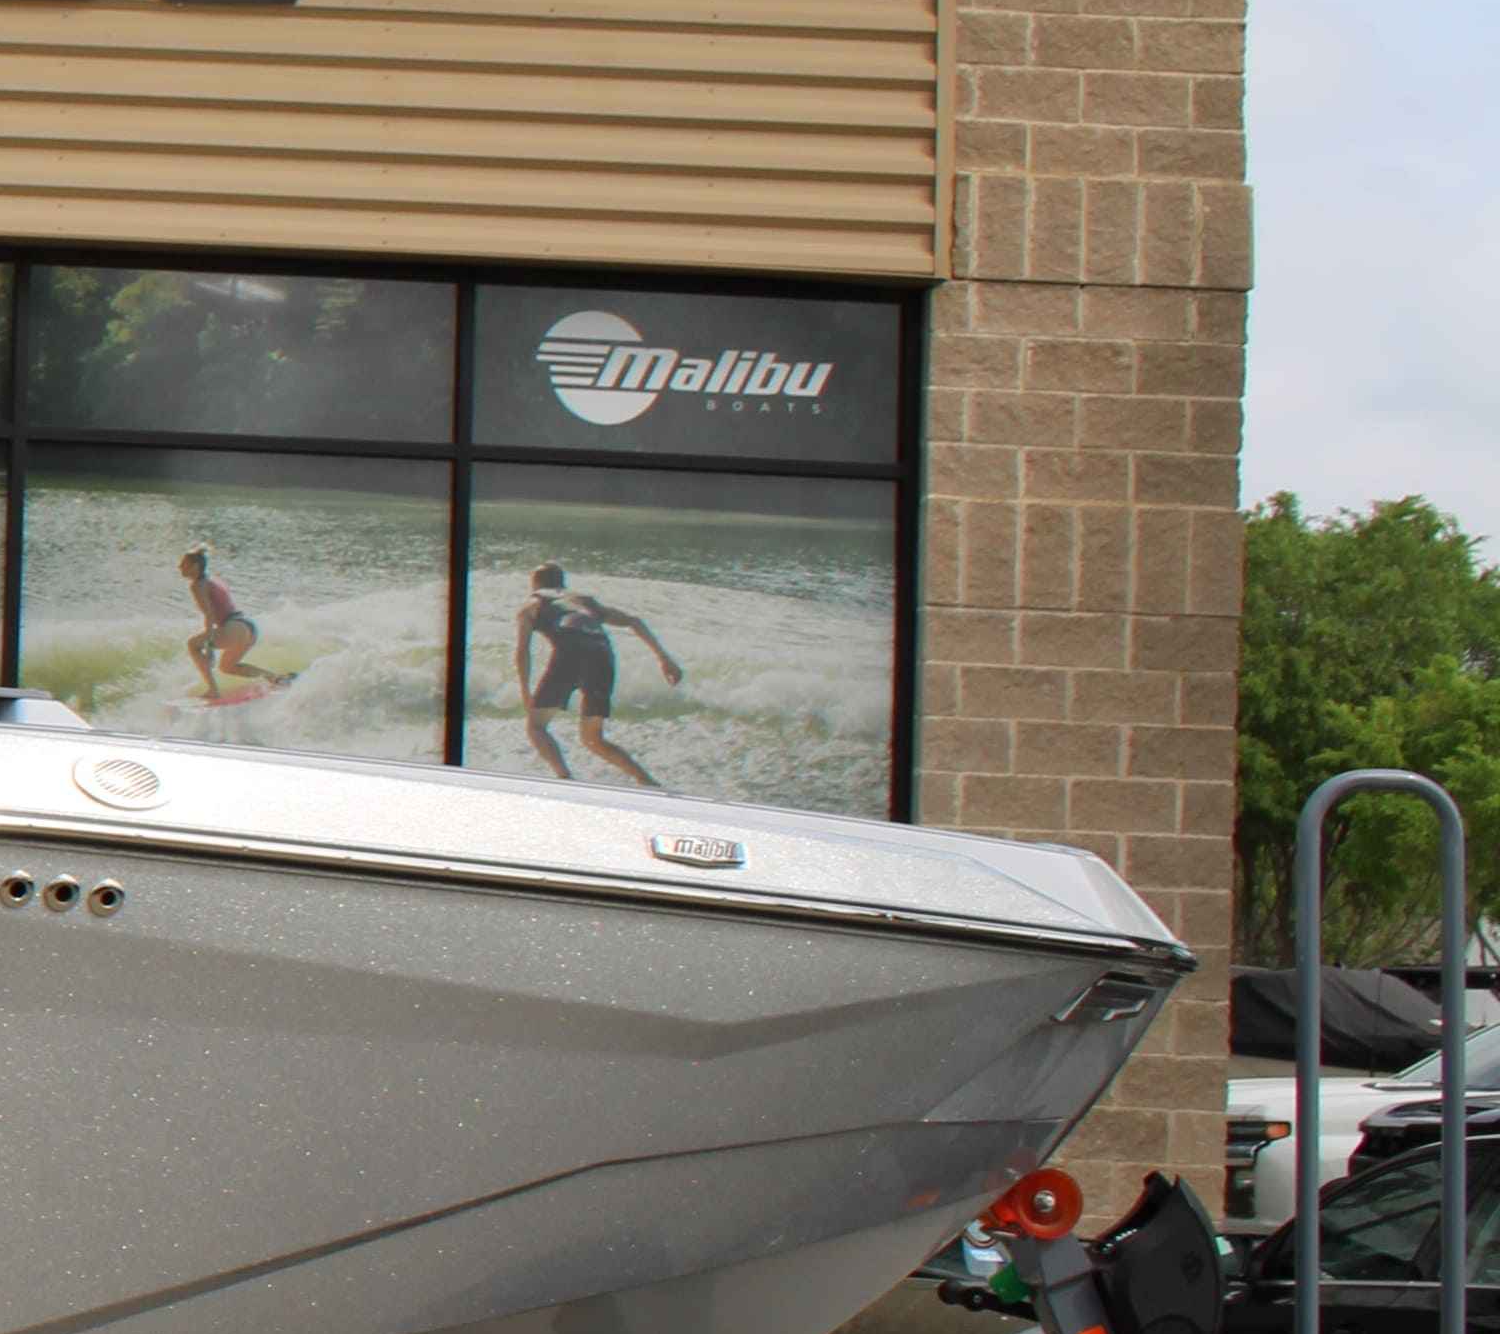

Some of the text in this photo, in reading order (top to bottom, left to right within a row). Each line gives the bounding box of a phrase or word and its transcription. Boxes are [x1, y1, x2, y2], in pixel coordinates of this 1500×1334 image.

[596, 346, 835, 397] Malibu
[705, 399, 820, 415] BOATS
[673, 838, 737, 859] Malibu
